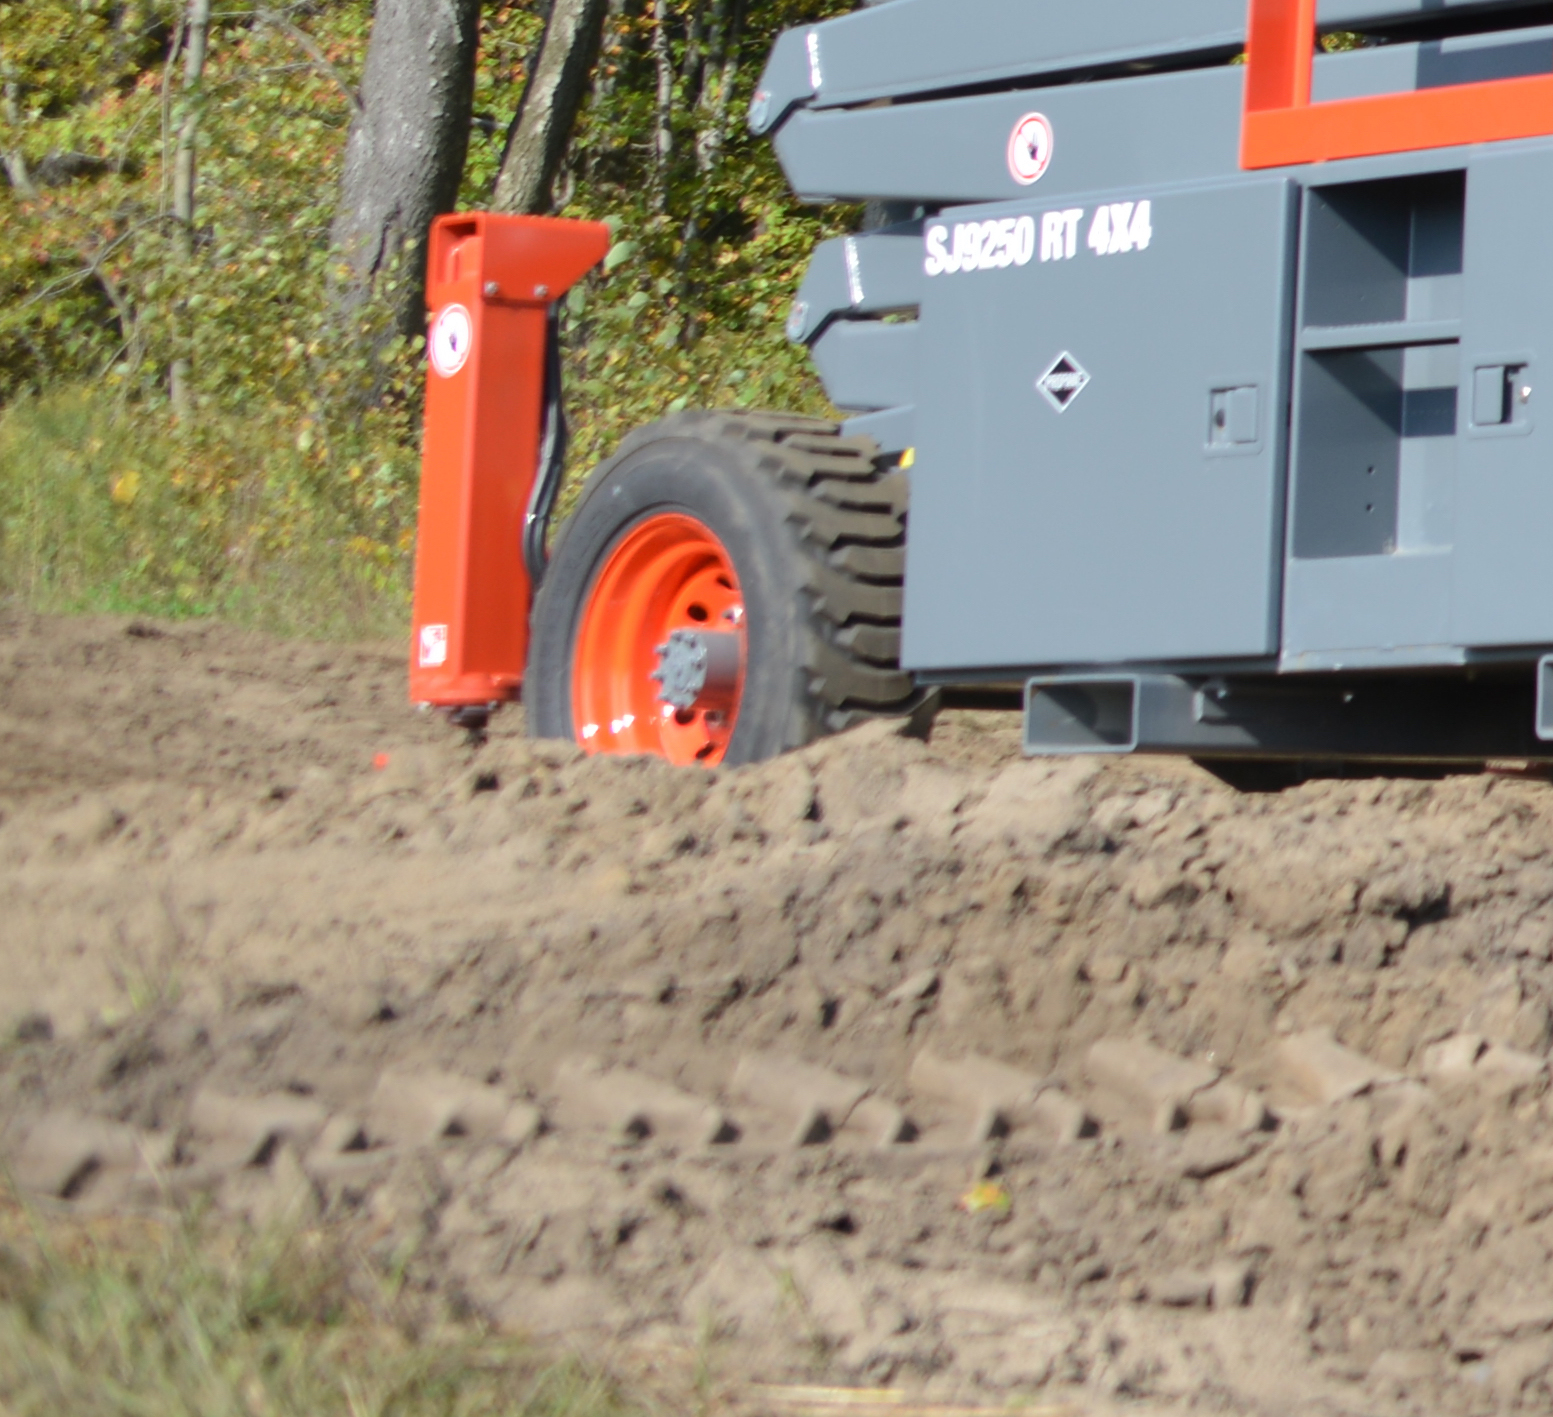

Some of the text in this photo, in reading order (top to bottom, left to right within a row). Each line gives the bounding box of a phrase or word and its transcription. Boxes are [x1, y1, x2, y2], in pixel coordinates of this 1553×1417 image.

[924, 199, 1153, 276] SJ9250 RT 4X4
